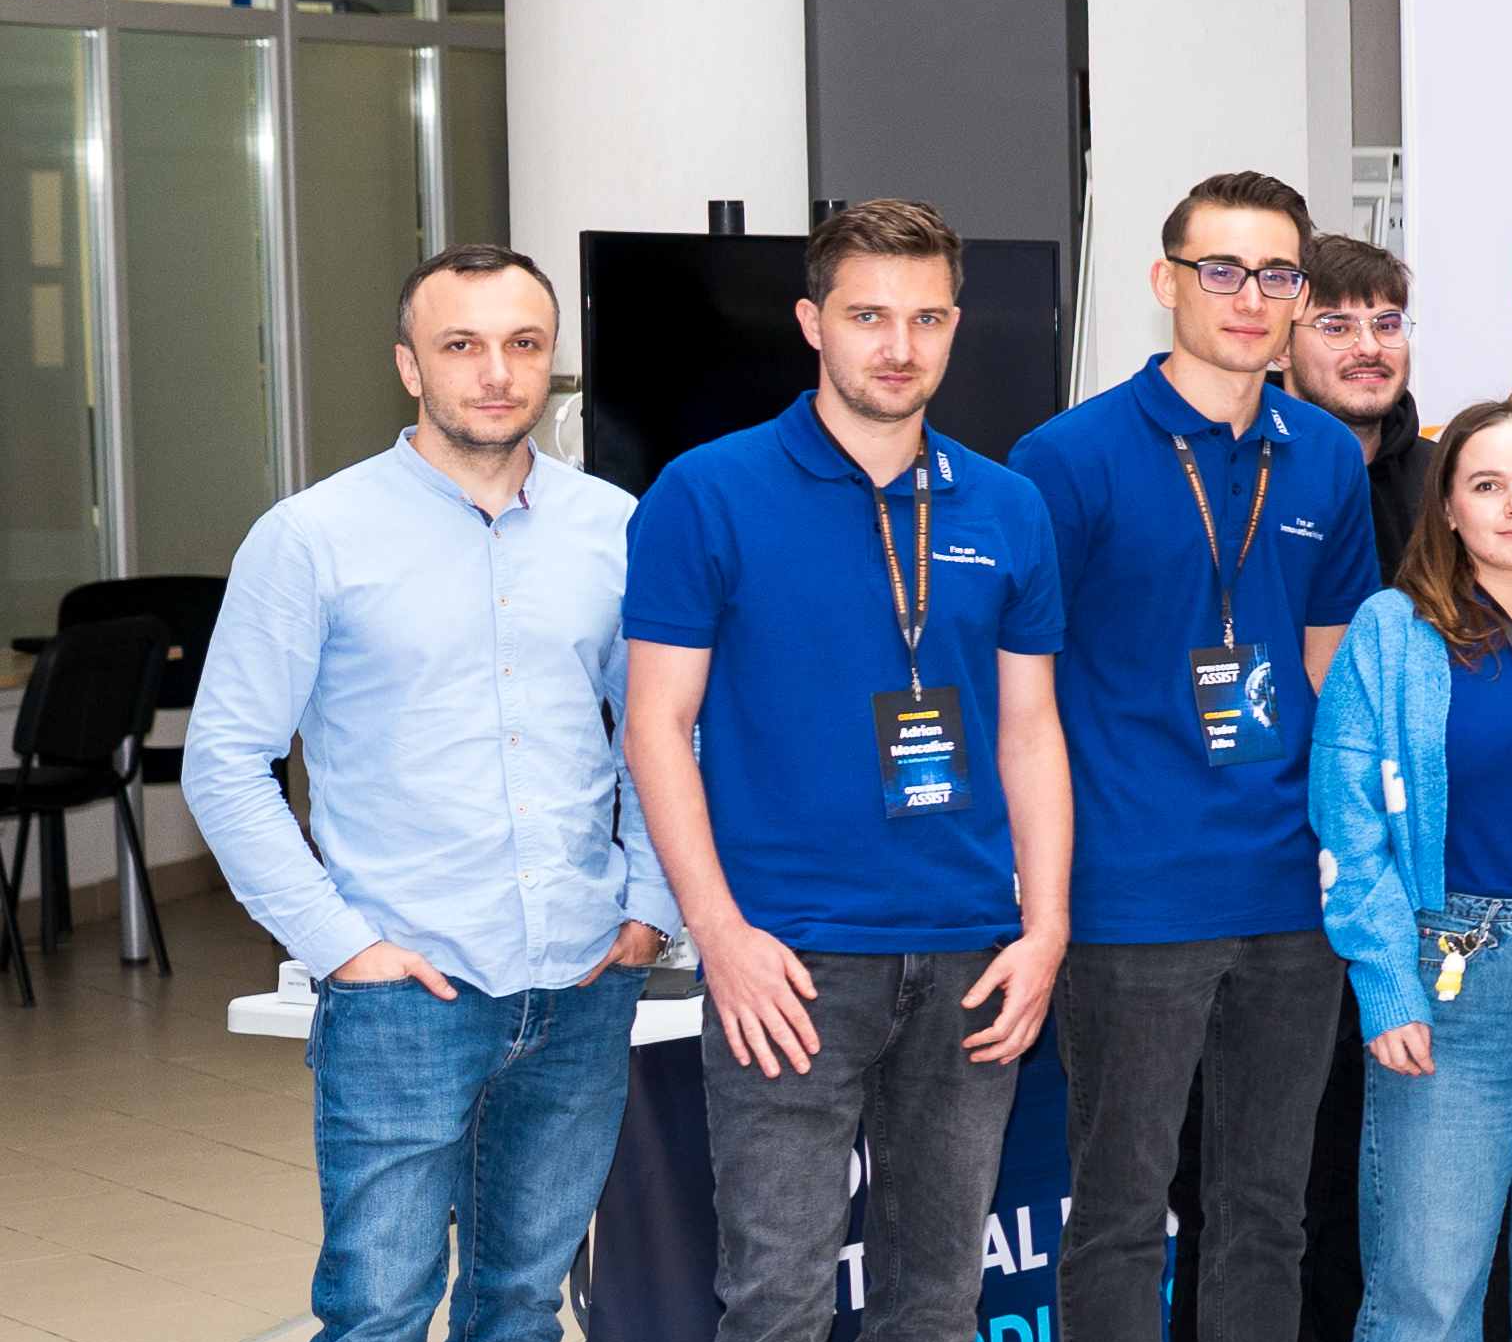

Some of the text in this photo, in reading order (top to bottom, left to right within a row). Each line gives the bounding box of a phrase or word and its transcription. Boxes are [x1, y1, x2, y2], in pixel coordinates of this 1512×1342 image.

[1198, 671, 1240, 685] ASSIST
[899, 725, 943, 739] Adrian
[890, 740, 955, 757] Moscaliuc
[906, 791, 953, 807] ASSIST
